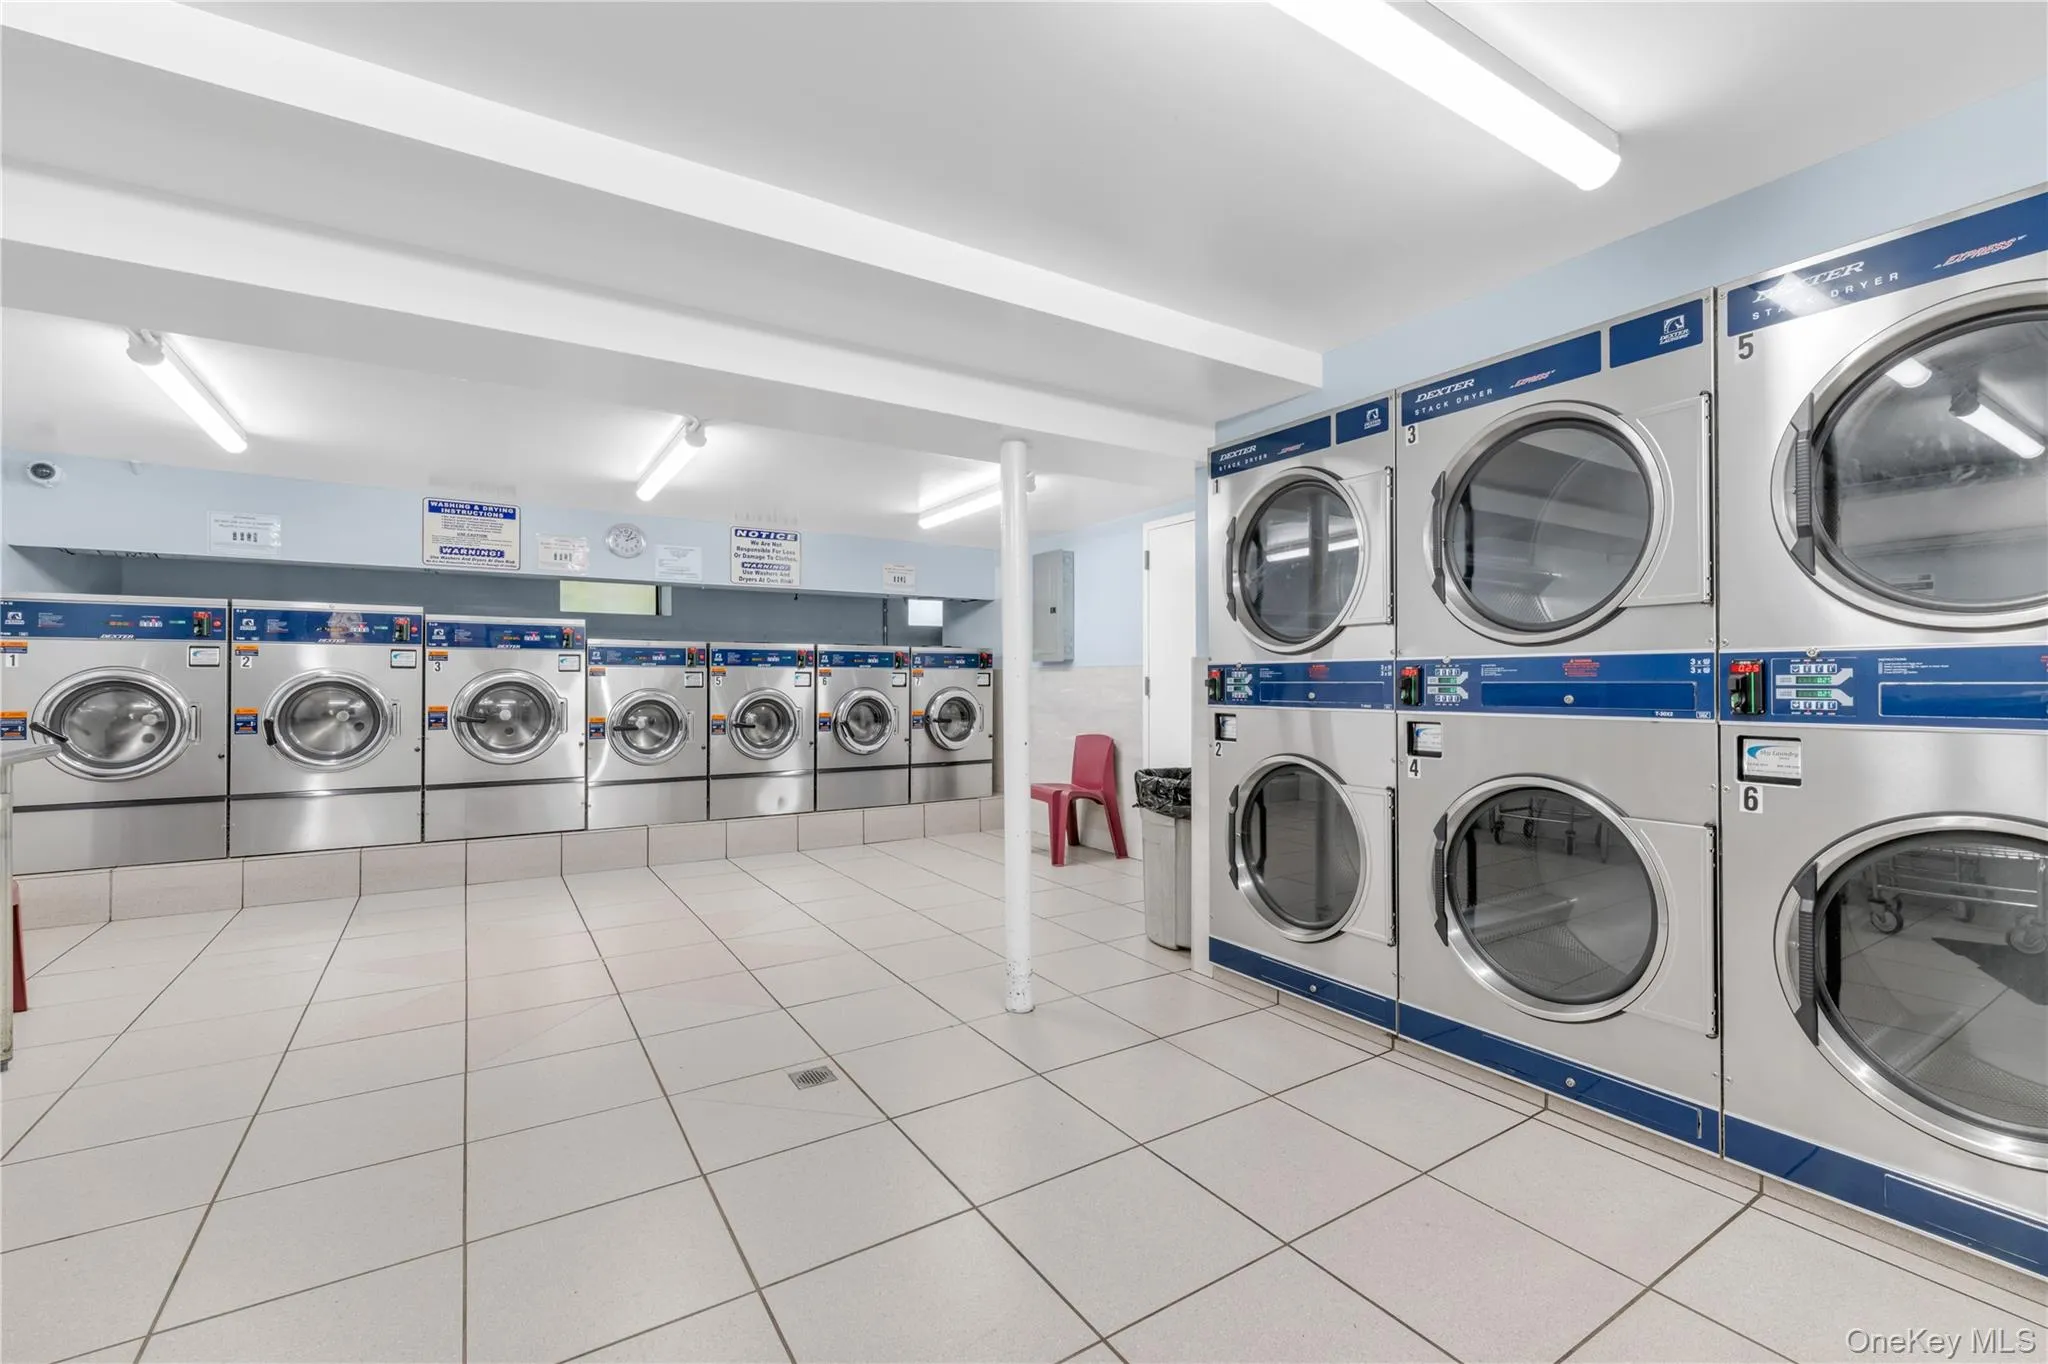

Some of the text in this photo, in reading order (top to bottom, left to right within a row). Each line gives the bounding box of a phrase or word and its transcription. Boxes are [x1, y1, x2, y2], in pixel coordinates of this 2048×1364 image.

[1830, 272, 1899, 297] DRYER
[1738, 333, 1754, 359] 5
[1415, 378, 1475, 403] DEXTER
[1414, 388, 1493, 416] STACK DRYER
[1408, 425, 1416, 444] 3
[1219, 444, 1257, 462] DEXTER
[1214, 479, 1219, 493] 1
[430, 501, 471, 510] WASHING
[482, 505, 514, 513] DRYING
[441, 508, 504, 518] INSTRUCTIONS
[736, 530, 796, 541] NOTICE
[442, 547, 501, 557] WARNING!
[736, 545, 771, 553] Responsible
[9, 654, 16, 667] 1
[242, 656, 251, 668] 2
[434, 661, 441, 672] 3
[715, 676, 721, 686] 5
[822, 677, 827, 686] 6
[914, 677, 921, 686] 7
[1215, 742, 1222, 757] 2
[1409, 759, 1419, 777] 4
[1743, 786, 1759, 811] 6
